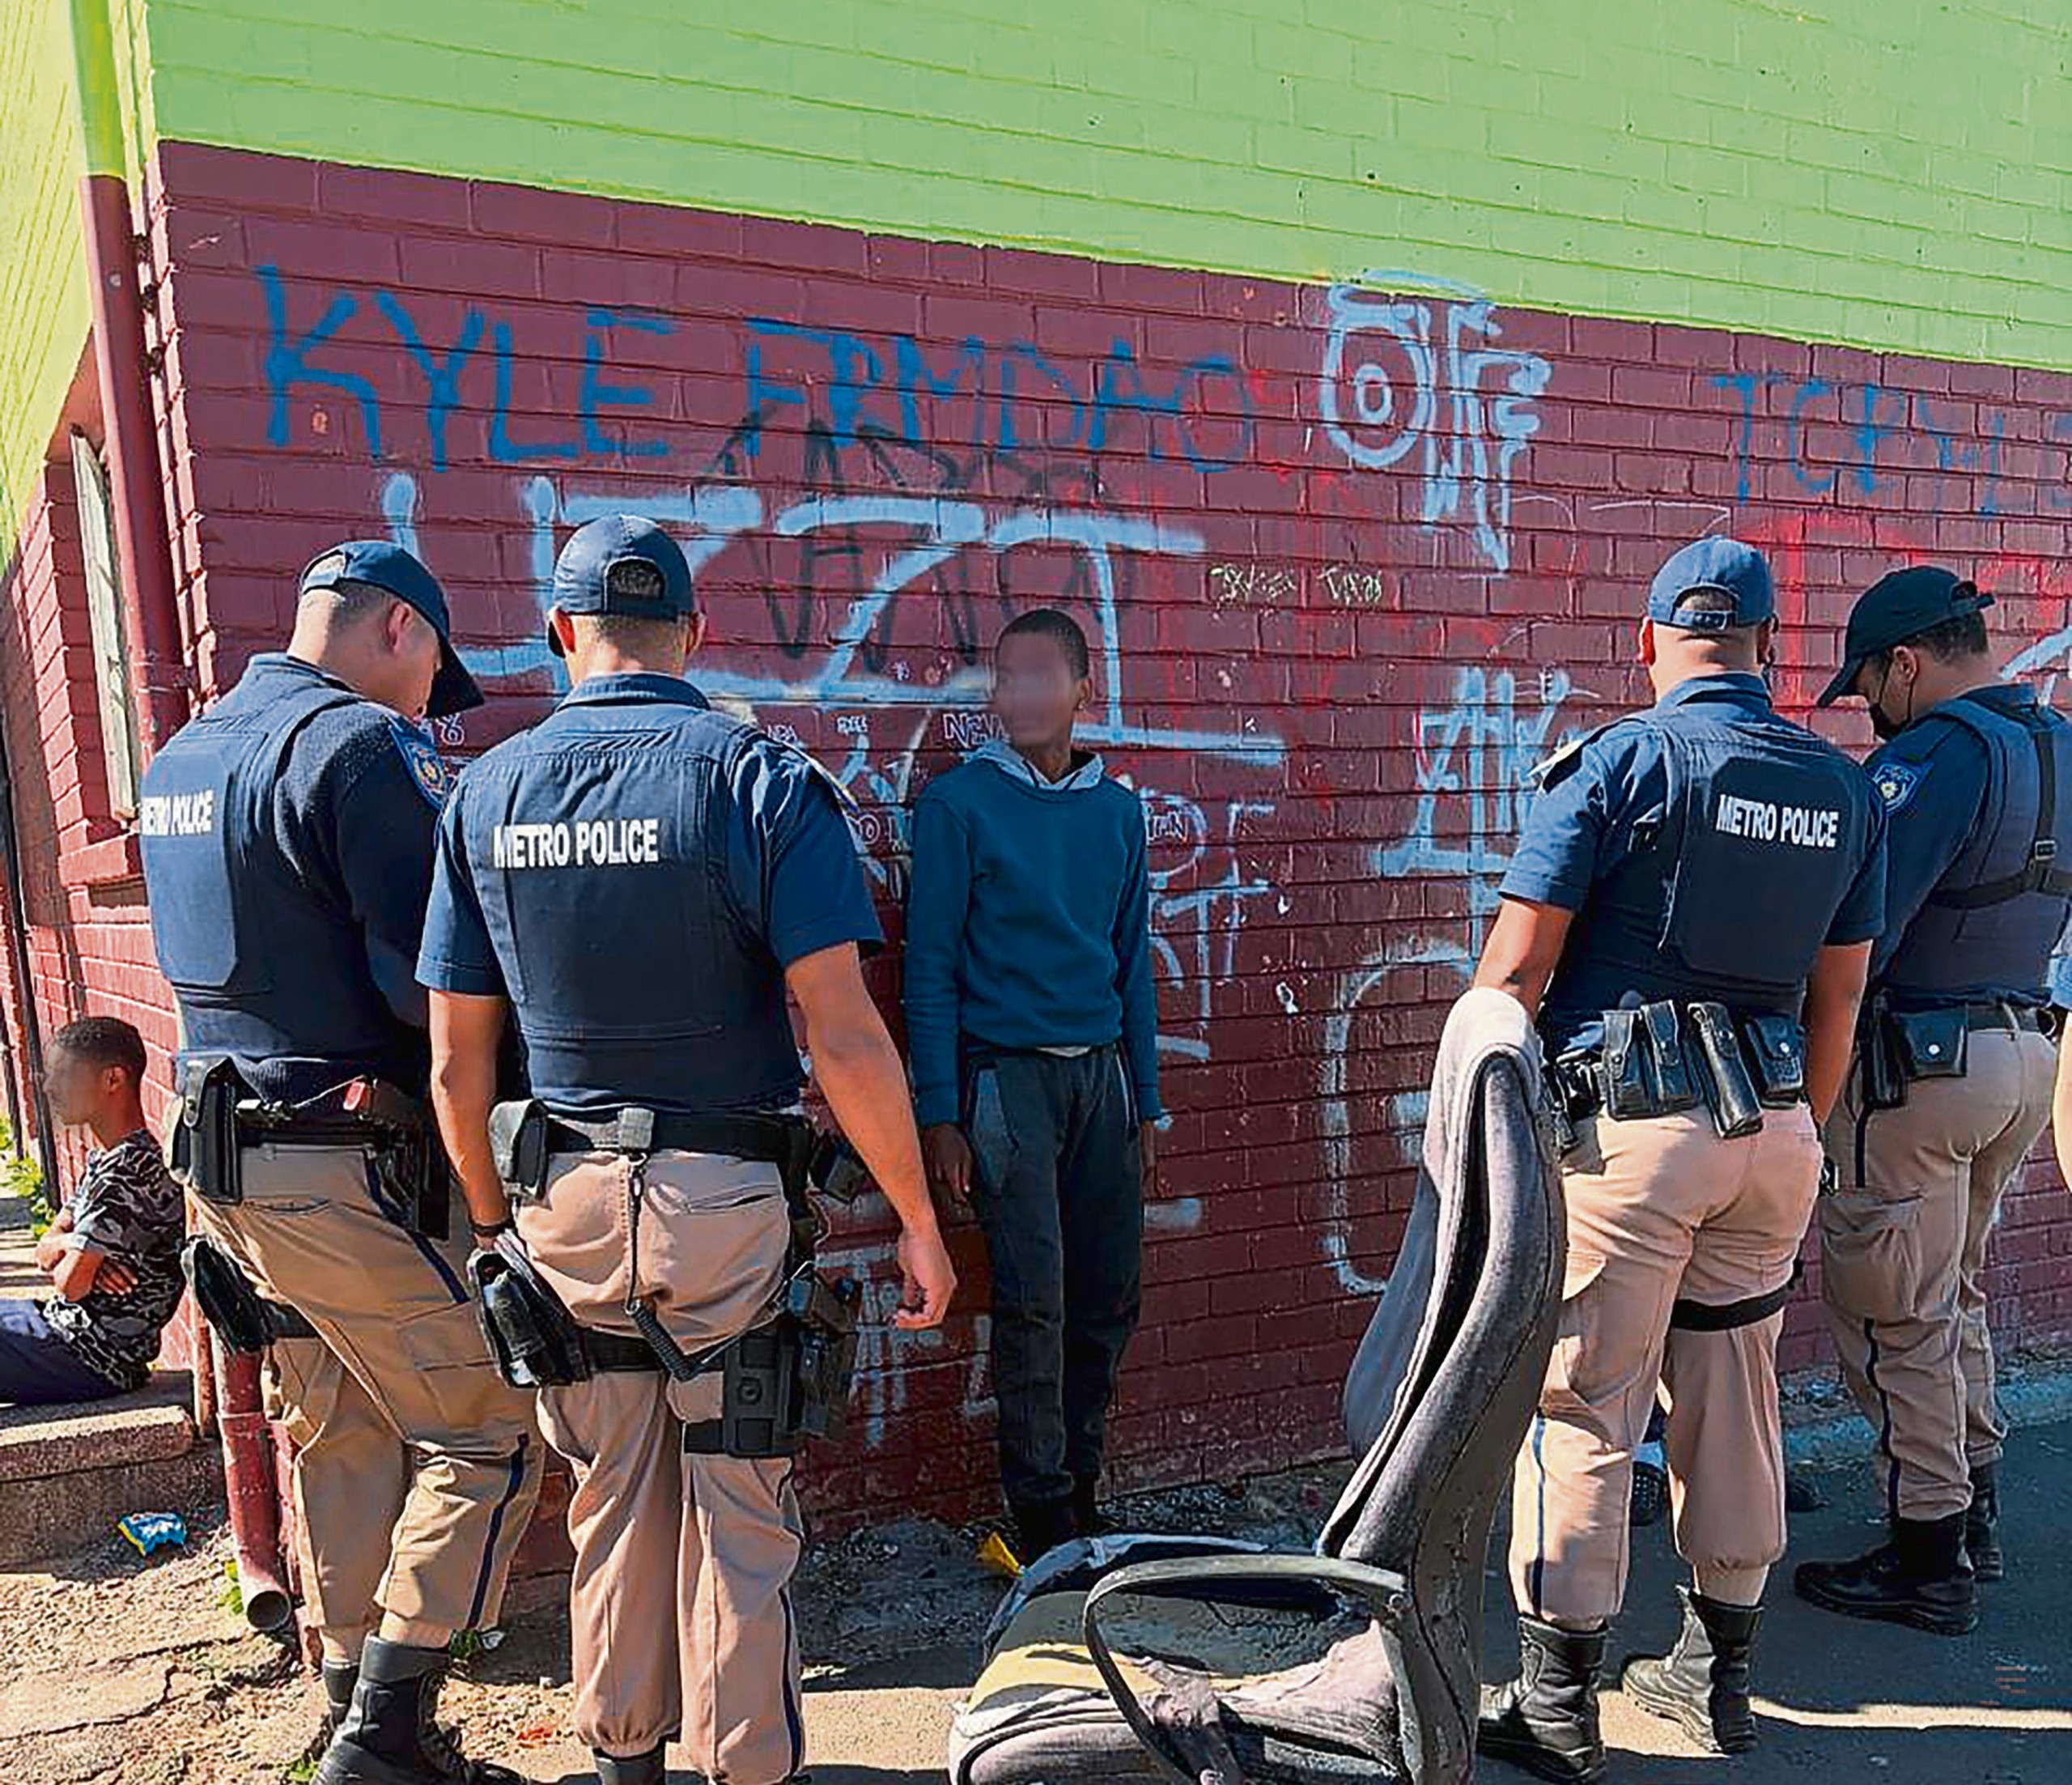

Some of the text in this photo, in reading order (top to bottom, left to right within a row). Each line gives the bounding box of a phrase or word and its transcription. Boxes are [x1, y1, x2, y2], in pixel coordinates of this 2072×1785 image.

[253, 263, 677, 473] KYLE
[494, 819, 659, 869] METRO POLICE
[1716, 793, 1839, 848] METRO POLICE
